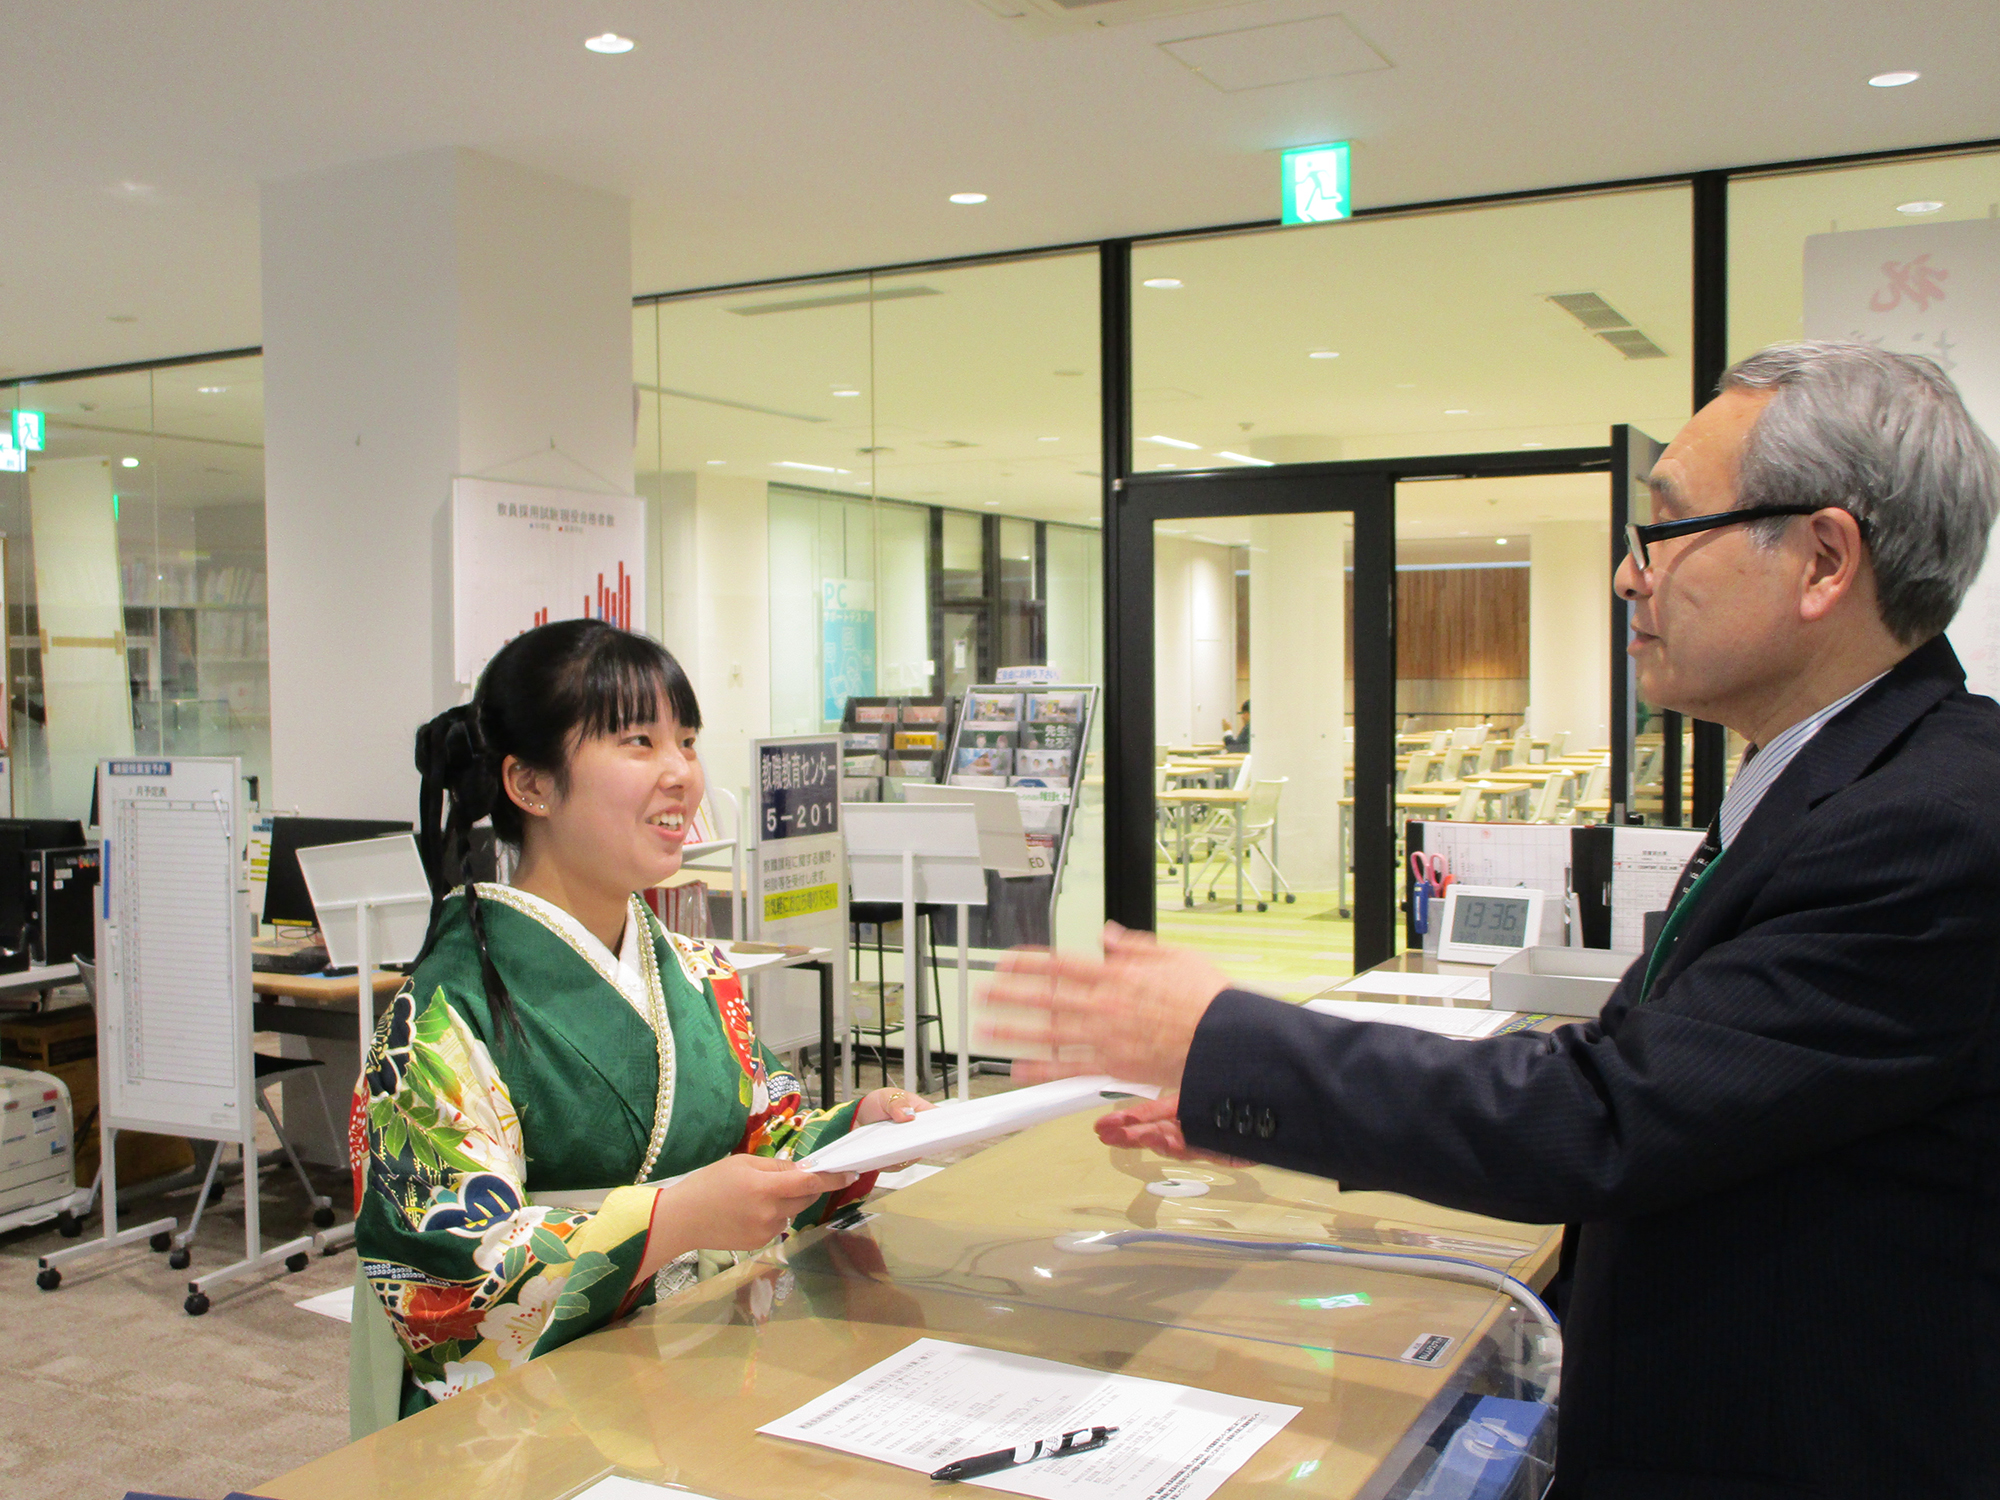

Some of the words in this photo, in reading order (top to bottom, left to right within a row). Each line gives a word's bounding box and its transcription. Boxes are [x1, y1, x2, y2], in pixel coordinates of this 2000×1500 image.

[824, 582, 848, 608] PC
[761, 754, 836, 791] 教職教育センター
[766, 802, 833, 832] 5-201
